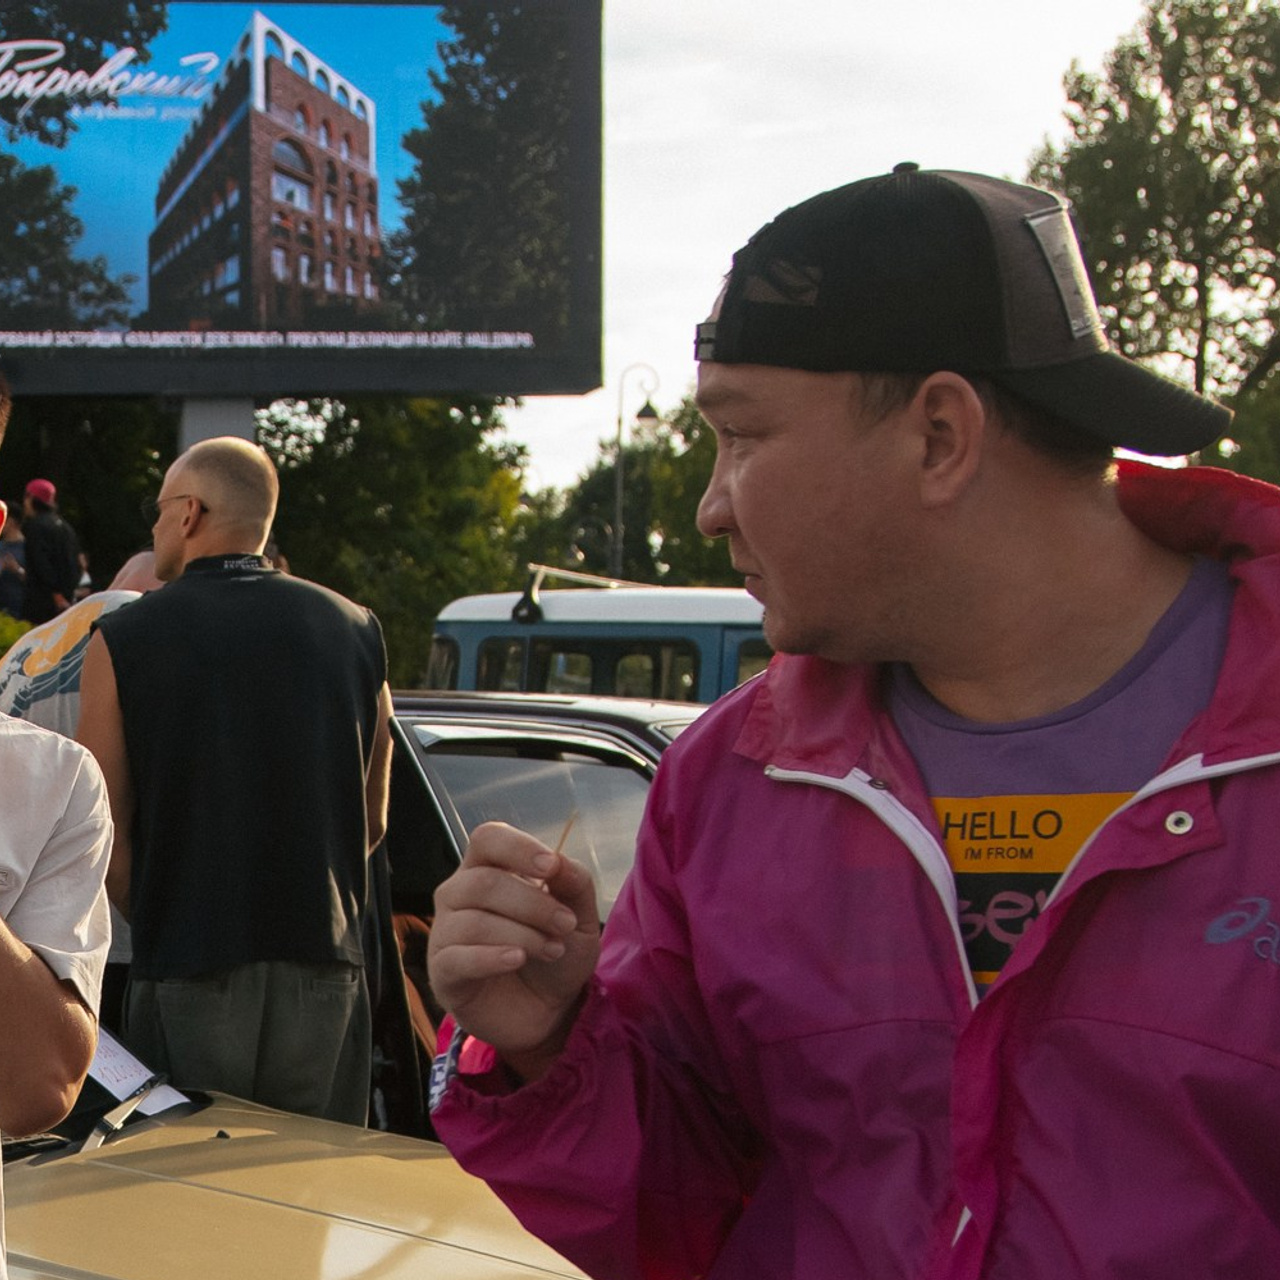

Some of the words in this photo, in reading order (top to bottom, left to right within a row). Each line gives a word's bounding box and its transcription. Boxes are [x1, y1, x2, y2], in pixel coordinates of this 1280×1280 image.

[941, 809, 1063, 841] HELLO
[964, 846, 983, 861] I'M
[986, 846, 1034, 861] FROM
